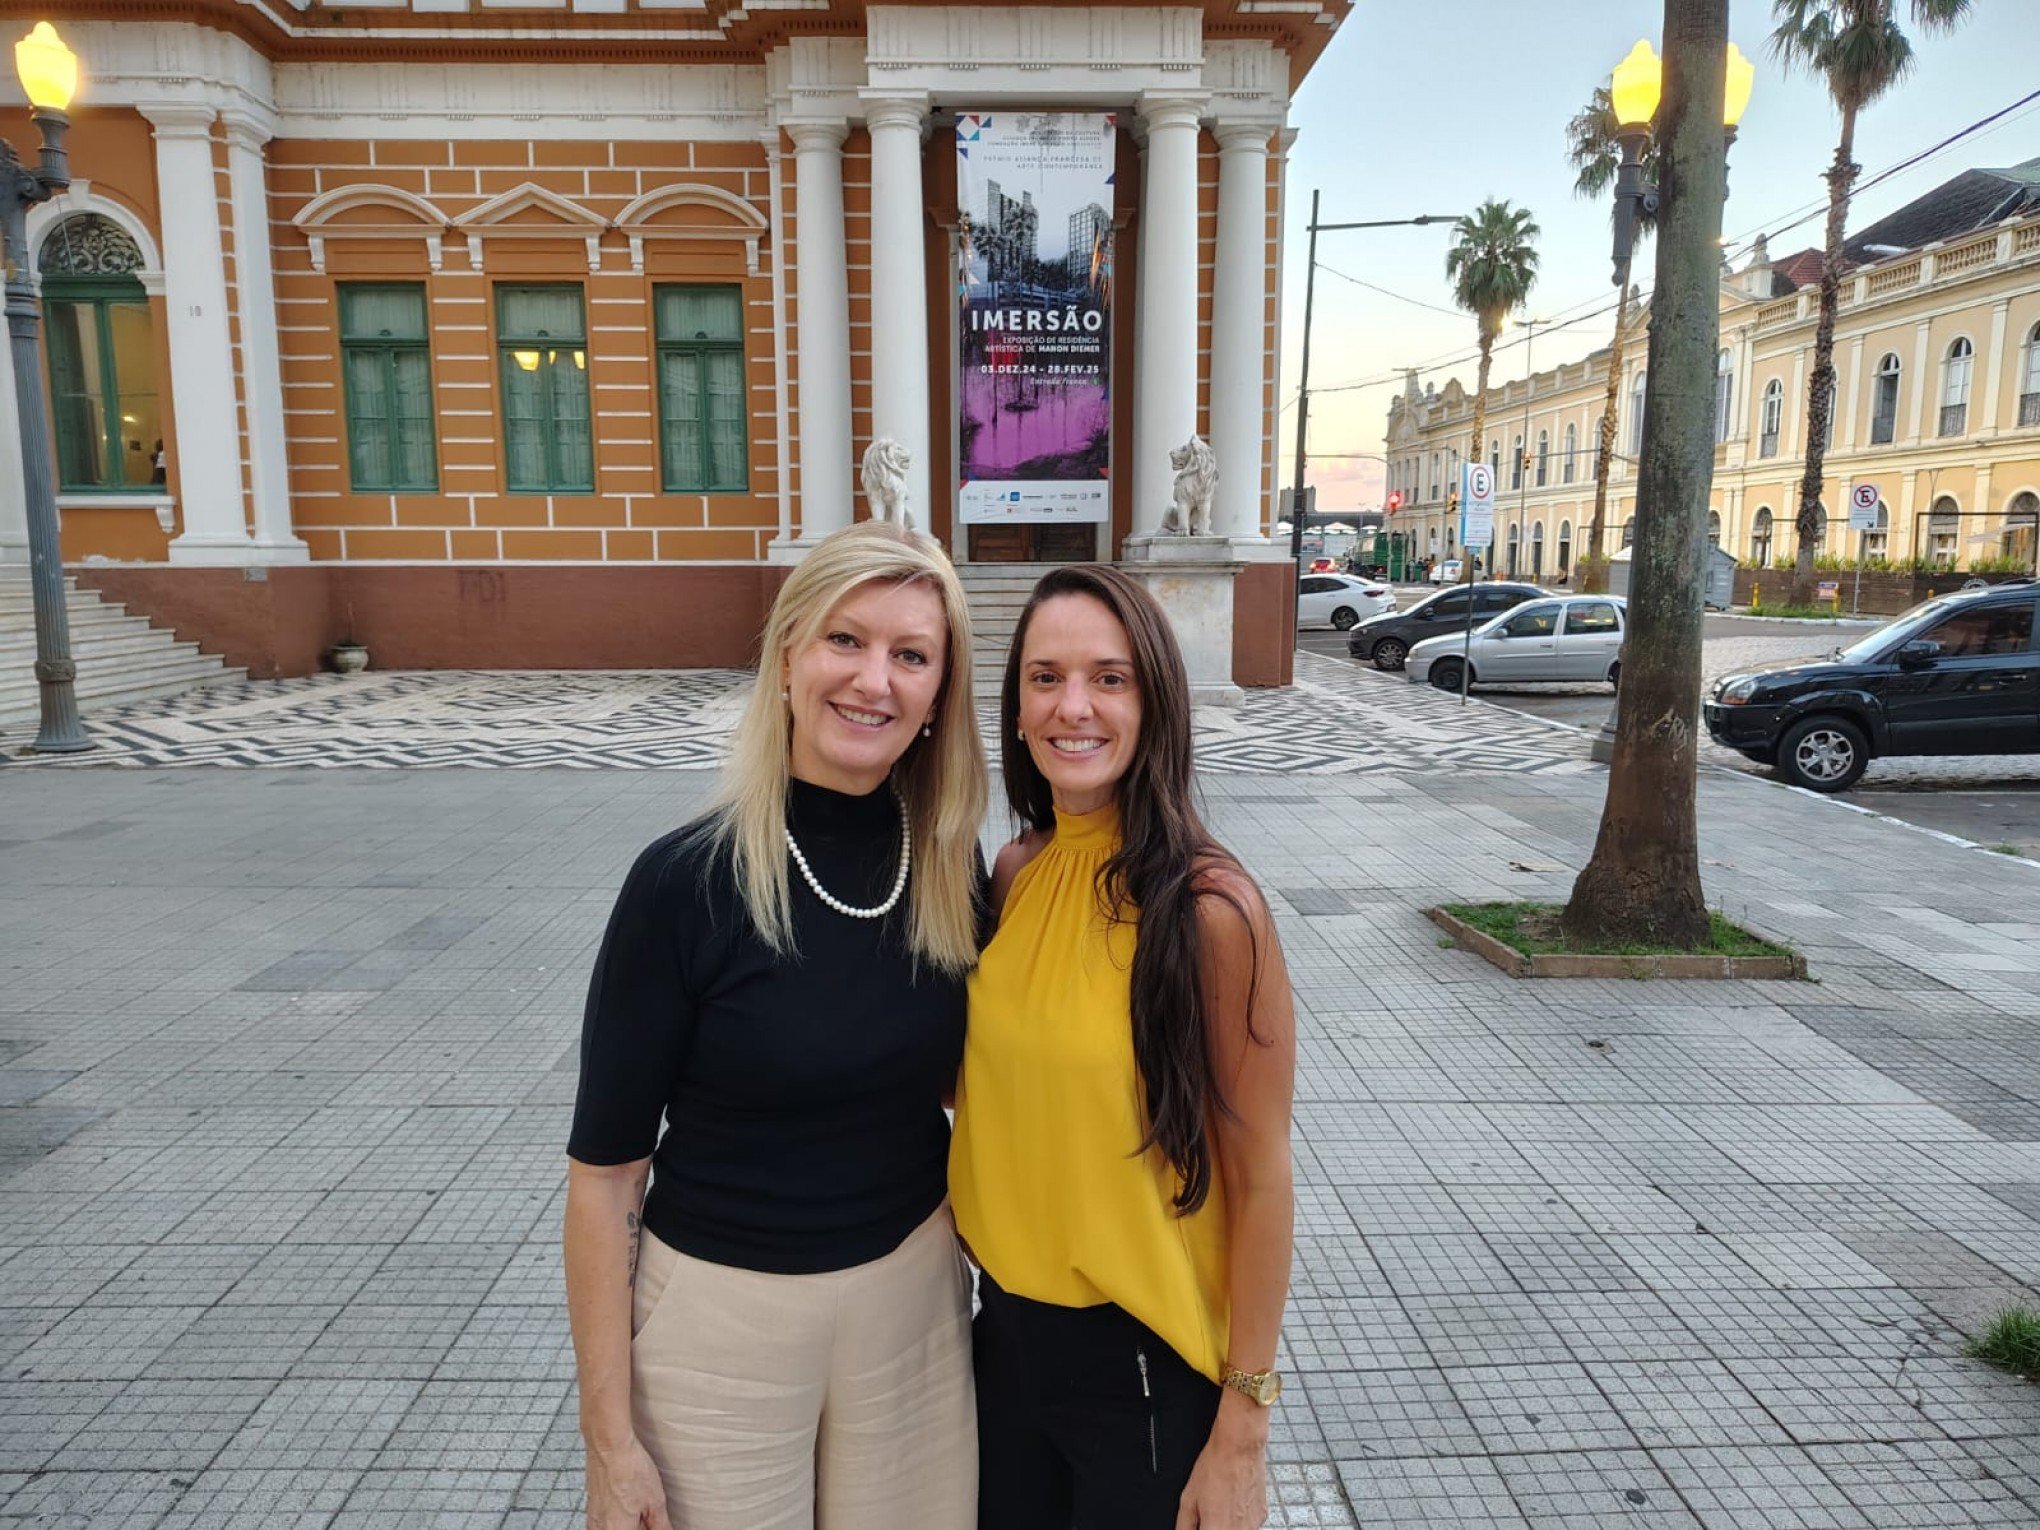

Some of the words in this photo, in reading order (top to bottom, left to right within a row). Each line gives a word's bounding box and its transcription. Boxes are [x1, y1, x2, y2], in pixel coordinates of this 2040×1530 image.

[972, 305, 1102, 331] IMERSÃO
[1003, 335, 1045, 345] EXPOSIÇÃO
[1047, 336, 1056, 344] DE
[1059, 335, 1100, 344] RESIDÊNCIA
[985, 344, 1023, 353] ARTÍSTICA
[1026, 345, 1035, 353] DE
[1039, 345, 1069, 353] MANON
[1071, 345, 1100, 353] DIEMER
[981, 365, 1037, 374] 03.DEZ.24
[1047, 365, 1099, 374] 28.FEV.25
[1476, 473, 1485, 491] E
[1860, 490, 1871, 503] E
